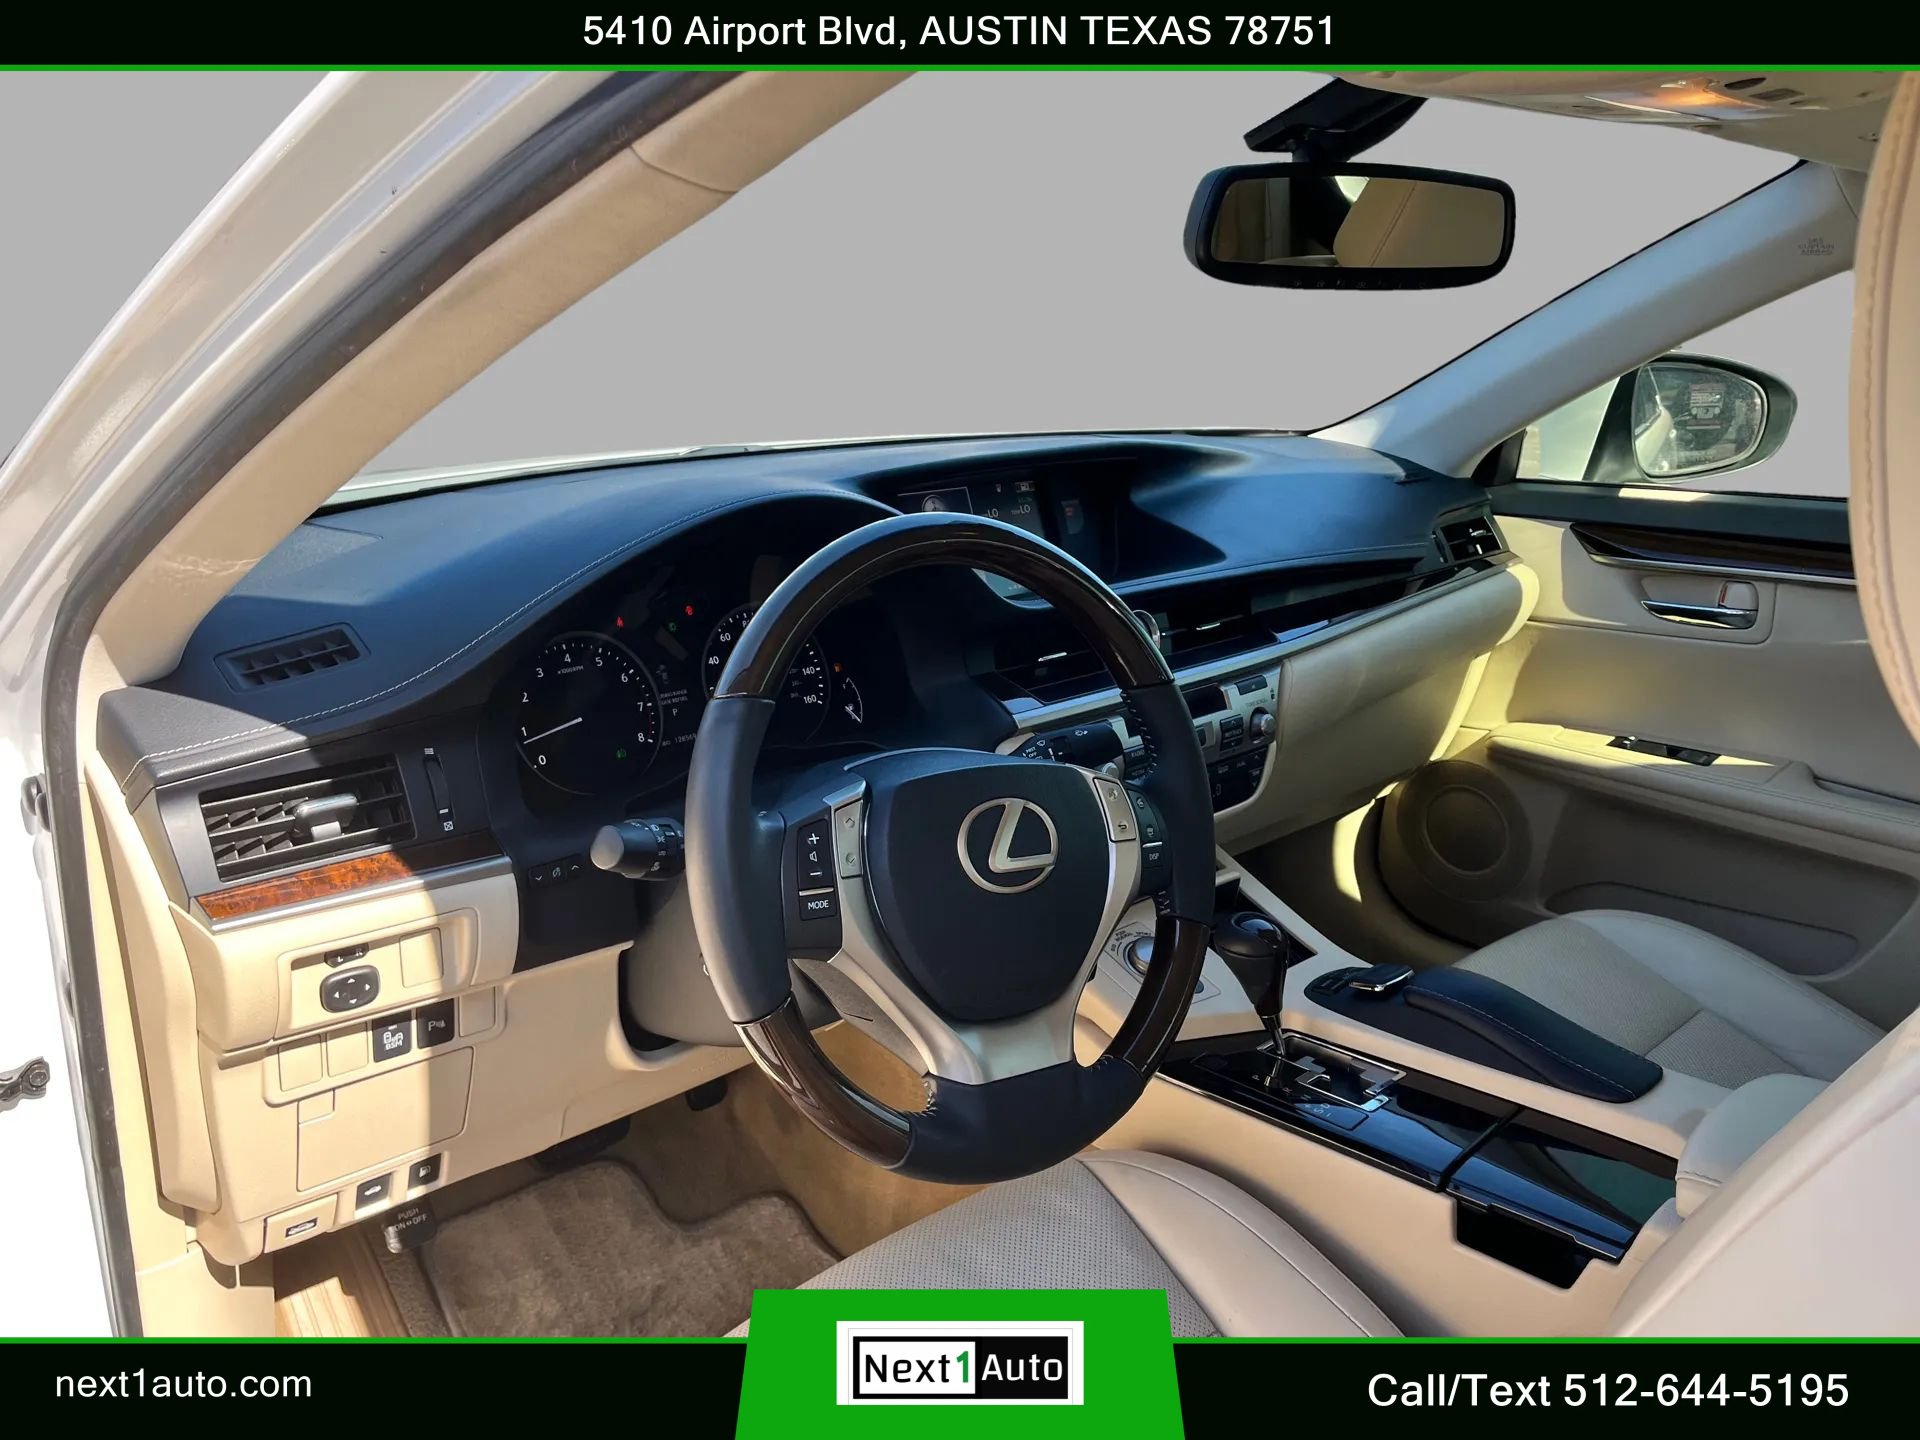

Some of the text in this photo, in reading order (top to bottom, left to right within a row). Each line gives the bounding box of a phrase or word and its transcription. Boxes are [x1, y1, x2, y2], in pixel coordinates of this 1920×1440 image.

[718, 632, 731, 643] 60
[564, 653, 571, 663] 4
[595, 656, 603, 667] 5
[707, 655, 719, 665] 40
[536, 667, 544, 678] 3
[802, 665, 815, 676] 140
[620, 672, 628, 683] 6
[521, 692, 529, 703] 2
[803, 694, 817, 704] 160
[636, 701, 644, 712] 7
[672, 708, 678, 717] P
[521, 727, 527, 737] 1
[637, 732, 645, 743] 8
[538, 755, 547, 766] 0
[1148, 852, 1160, 861] DISP
[807, 899, 830, 911] MODE
[385, 1039, 403, 1051] BSM
[397, 1207, 419, 1221] PUSH
[411, 1213, 427, 1225] OFF
